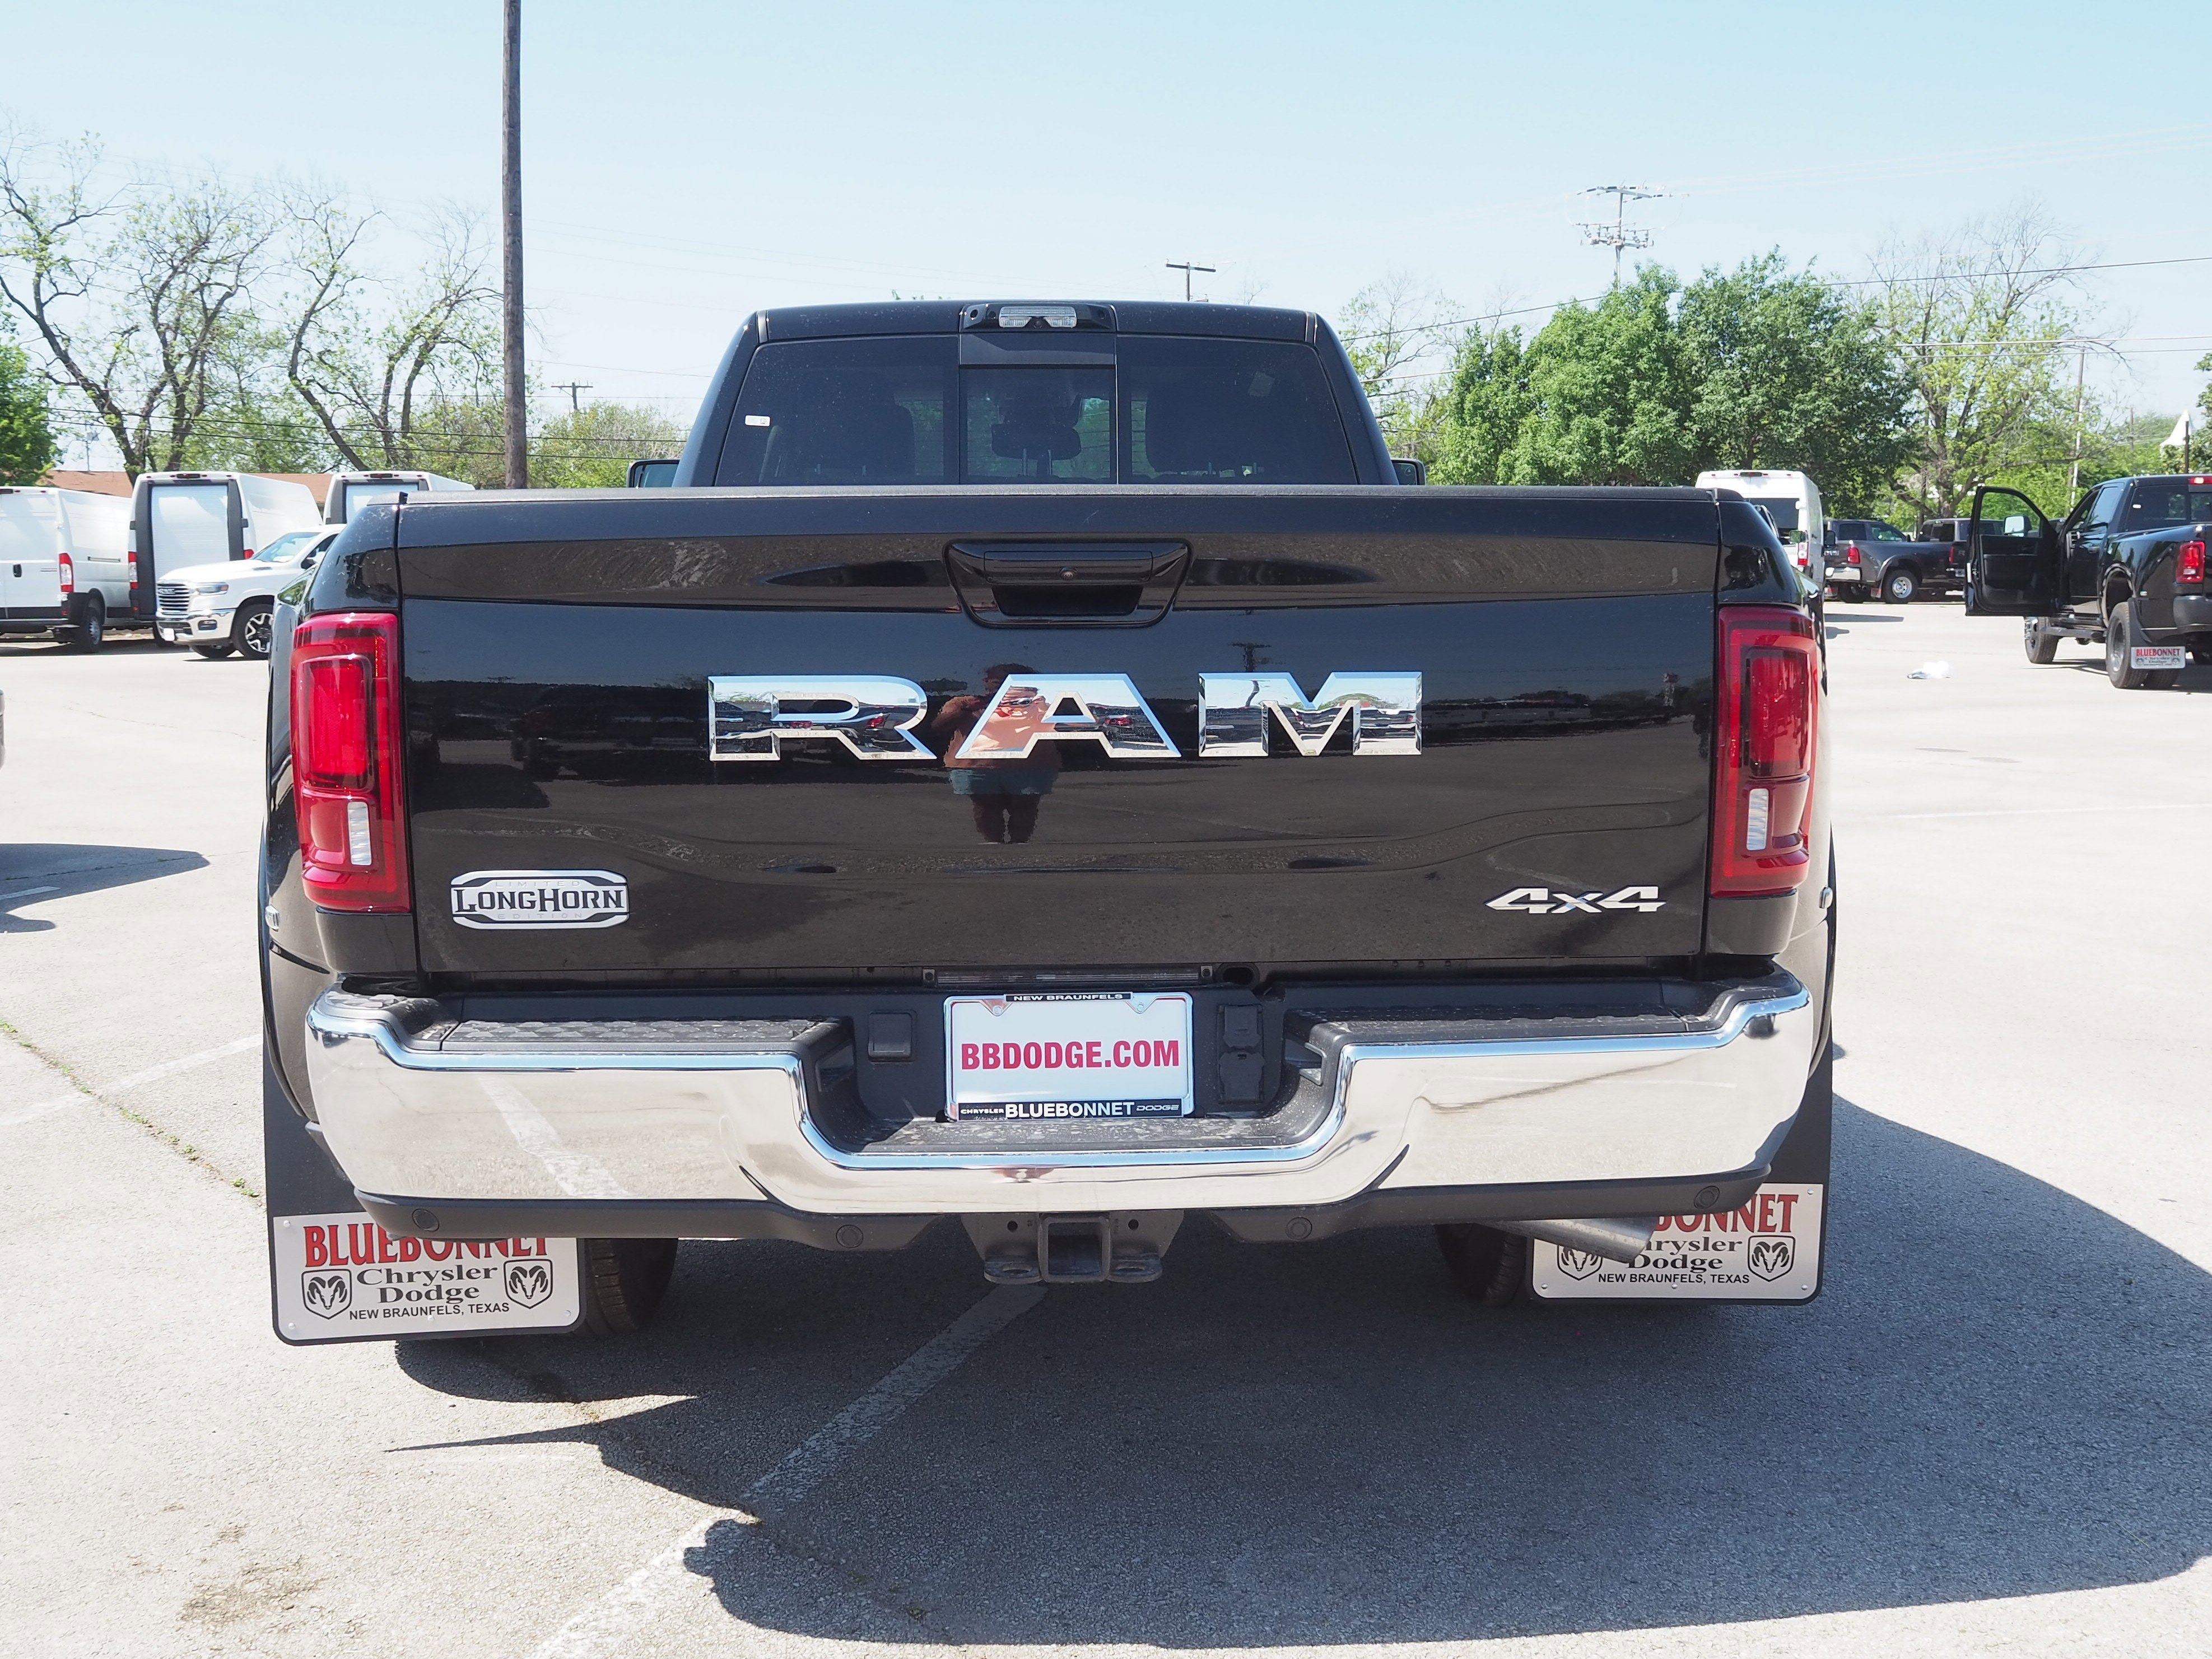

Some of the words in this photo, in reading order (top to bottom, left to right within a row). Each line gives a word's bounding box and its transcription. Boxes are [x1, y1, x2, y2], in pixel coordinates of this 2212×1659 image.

[2136, 648, 2181, 656] BLUEBONNET
[707, 672, 1423, 761] RAM
[961, 1040, 1180, 1070] BBDODGE.COM
[1005, 1102, 1135, 1119] BLUEBONNET
[1626, 1253, 1723, 1274] Dodge
[357, 1264, 498, 1287] Chrysler
[1598, 1273, 1628, 1283] NEW
[1629, 1273, 1706, 1285] BRAUNFELS,
[1711, 1274, 1750, 1284] TEXAS
[378, 1284, 480, 1304] Dodge
[349, 1308, 379, 1321] NEW
[383, 1304, 464, 1319] BRAUNFELS,
[469, 1302, 510, 1314] TEXAS
